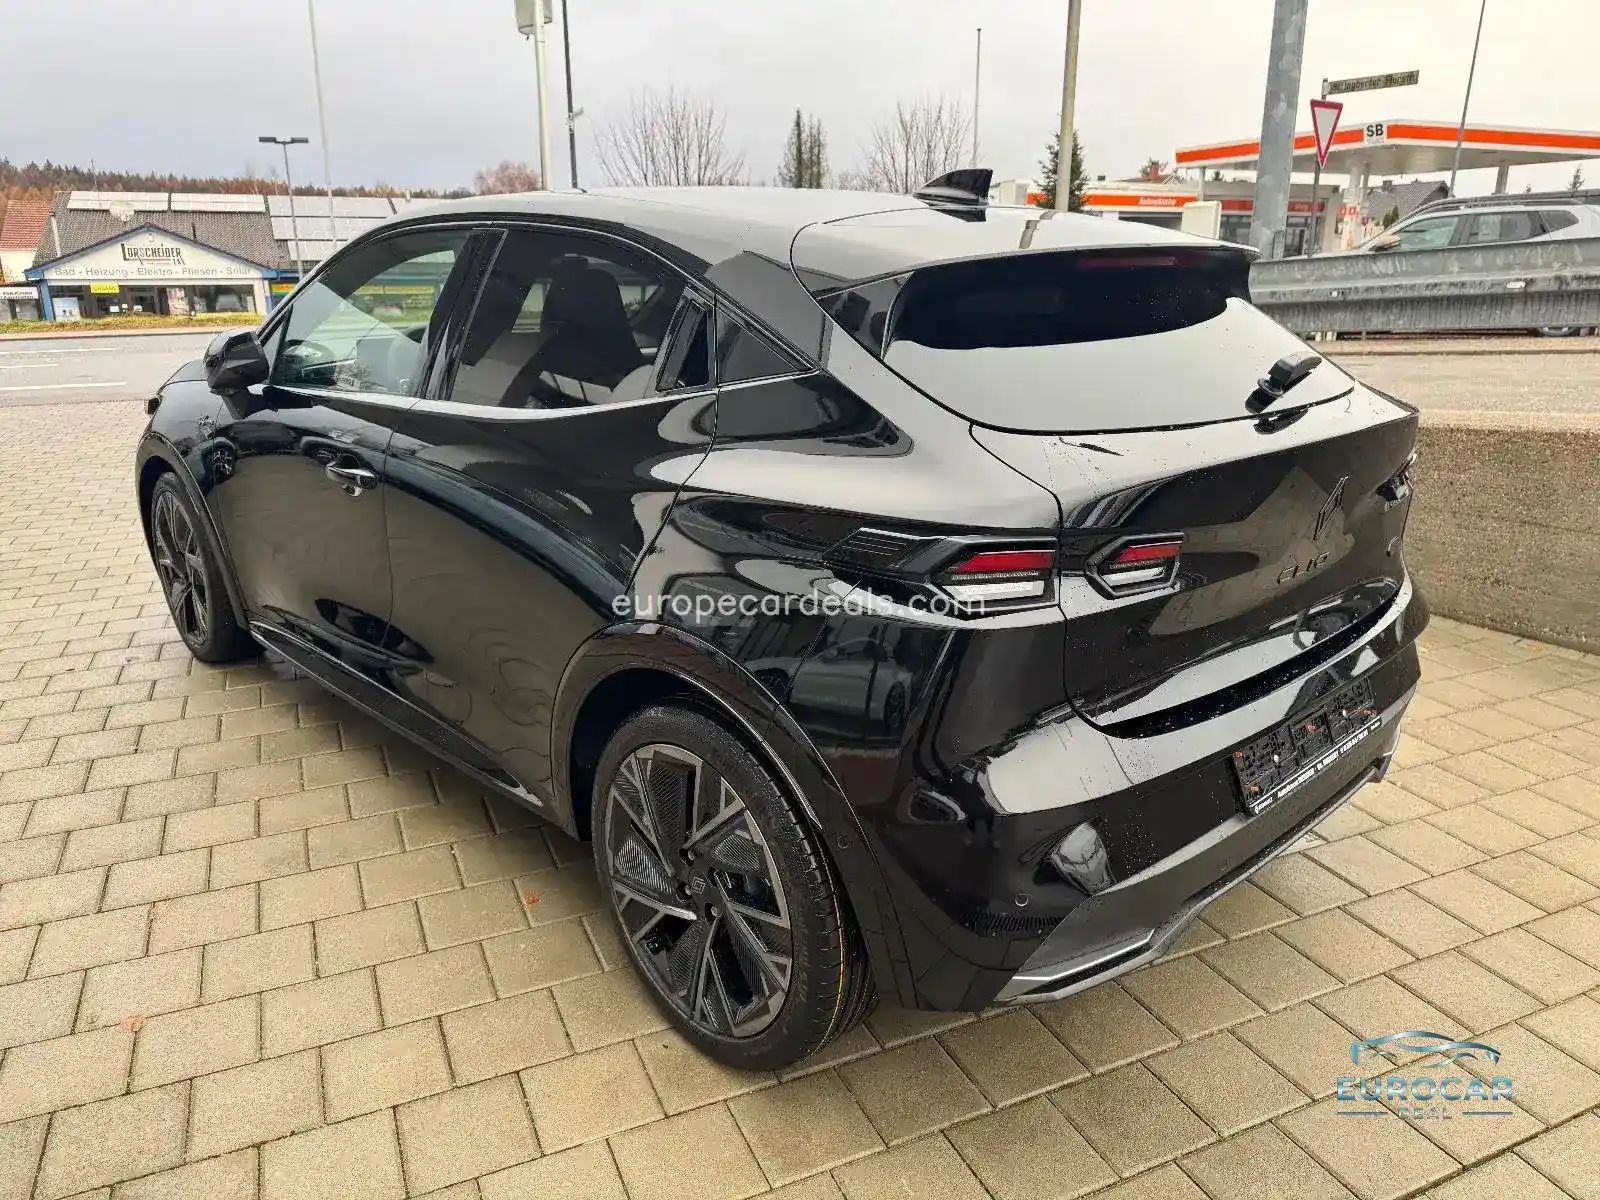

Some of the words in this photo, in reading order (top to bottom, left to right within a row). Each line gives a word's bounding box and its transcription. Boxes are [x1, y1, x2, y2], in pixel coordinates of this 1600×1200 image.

[1366, 123, 1384, 137] SB
[86, 267, 128, 277] Heizung
[137, 267, 173, 276] Elektro
[182, 267, 217, 275] Fliesen
[1277, 551, 1330, 584] CLIO
